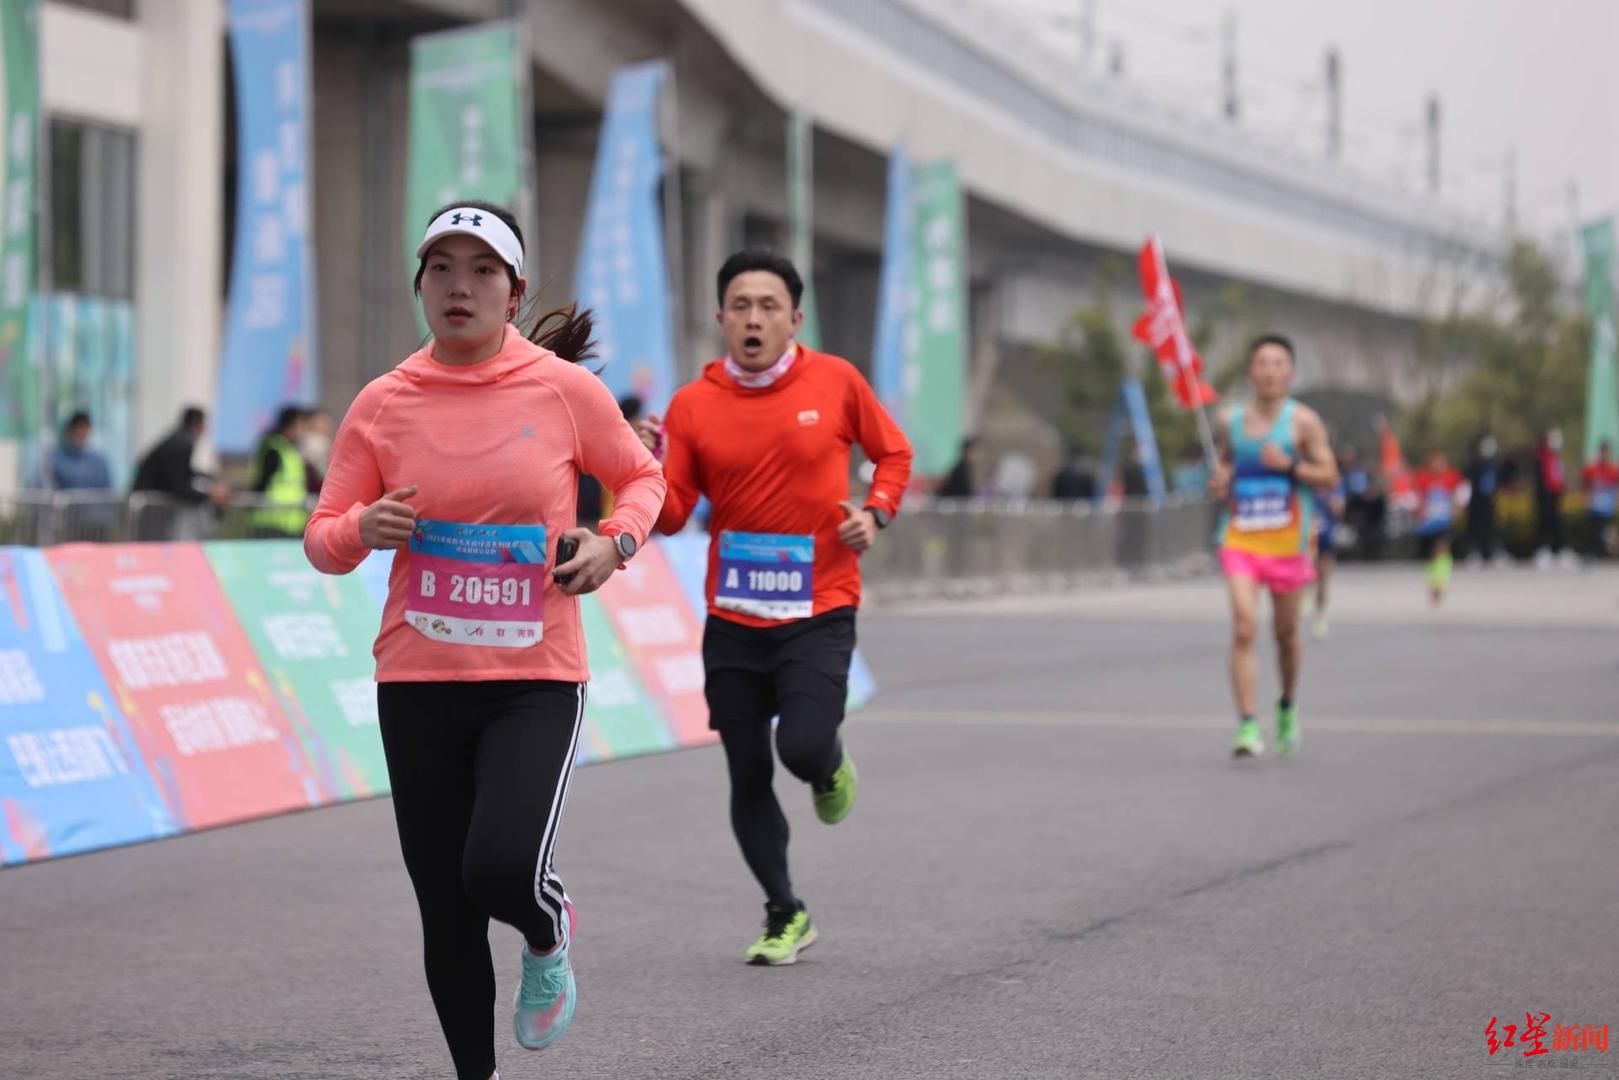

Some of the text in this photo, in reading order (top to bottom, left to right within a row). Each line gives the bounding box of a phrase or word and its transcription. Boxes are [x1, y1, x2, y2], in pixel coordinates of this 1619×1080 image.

[420, 570, 530, 606] B 20591
[725, 568, 802, 592] A 11000
